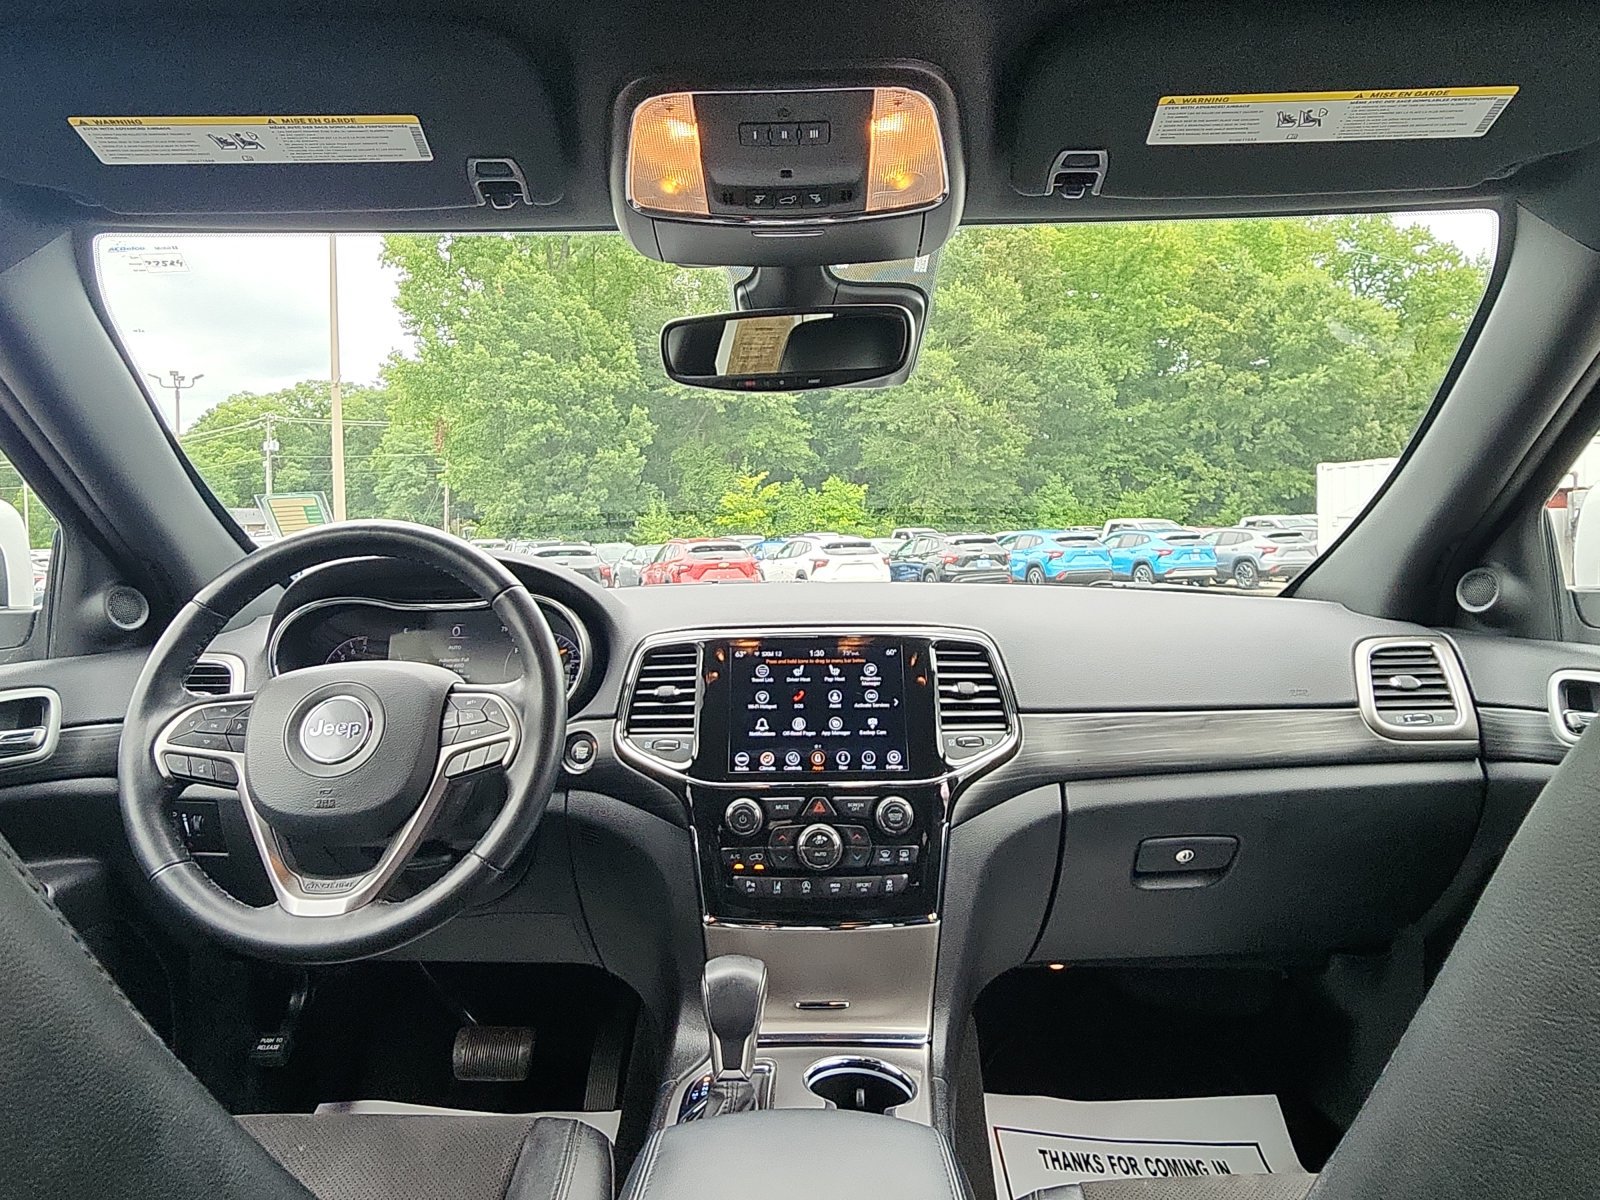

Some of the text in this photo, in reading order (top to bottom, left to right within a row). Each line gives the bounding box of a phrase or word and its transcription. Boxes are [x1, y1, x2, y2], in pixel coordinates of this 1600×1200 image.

[809, 649, 825, 657] 1:30
[309, 719, 363, 739] Jeep
[1038, 1148, 1231, 1177] THANKS FOR COMING IN
